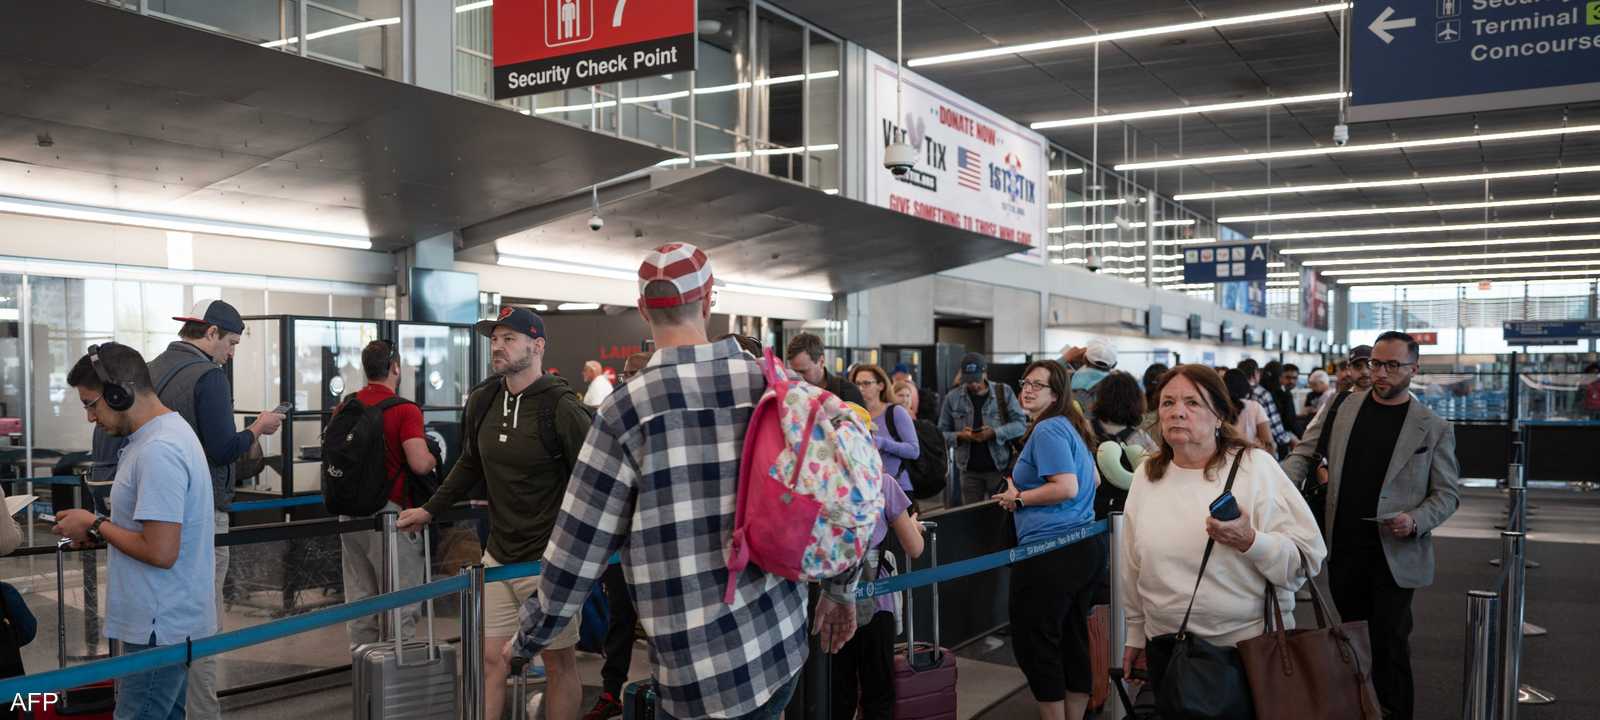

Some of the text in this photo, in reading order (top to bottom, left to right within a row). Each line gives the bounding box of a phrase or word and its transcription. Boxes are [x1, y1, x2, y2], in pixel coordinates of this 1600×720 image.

[1472, 7, 1578, 36] Terminal
[508, 46, 678, 89] Security Check Point
[939, 105, 996, 146] DONATE NOW
[924, 135, 947, 172] TIX
[1251, 245, 1265, 261] A
